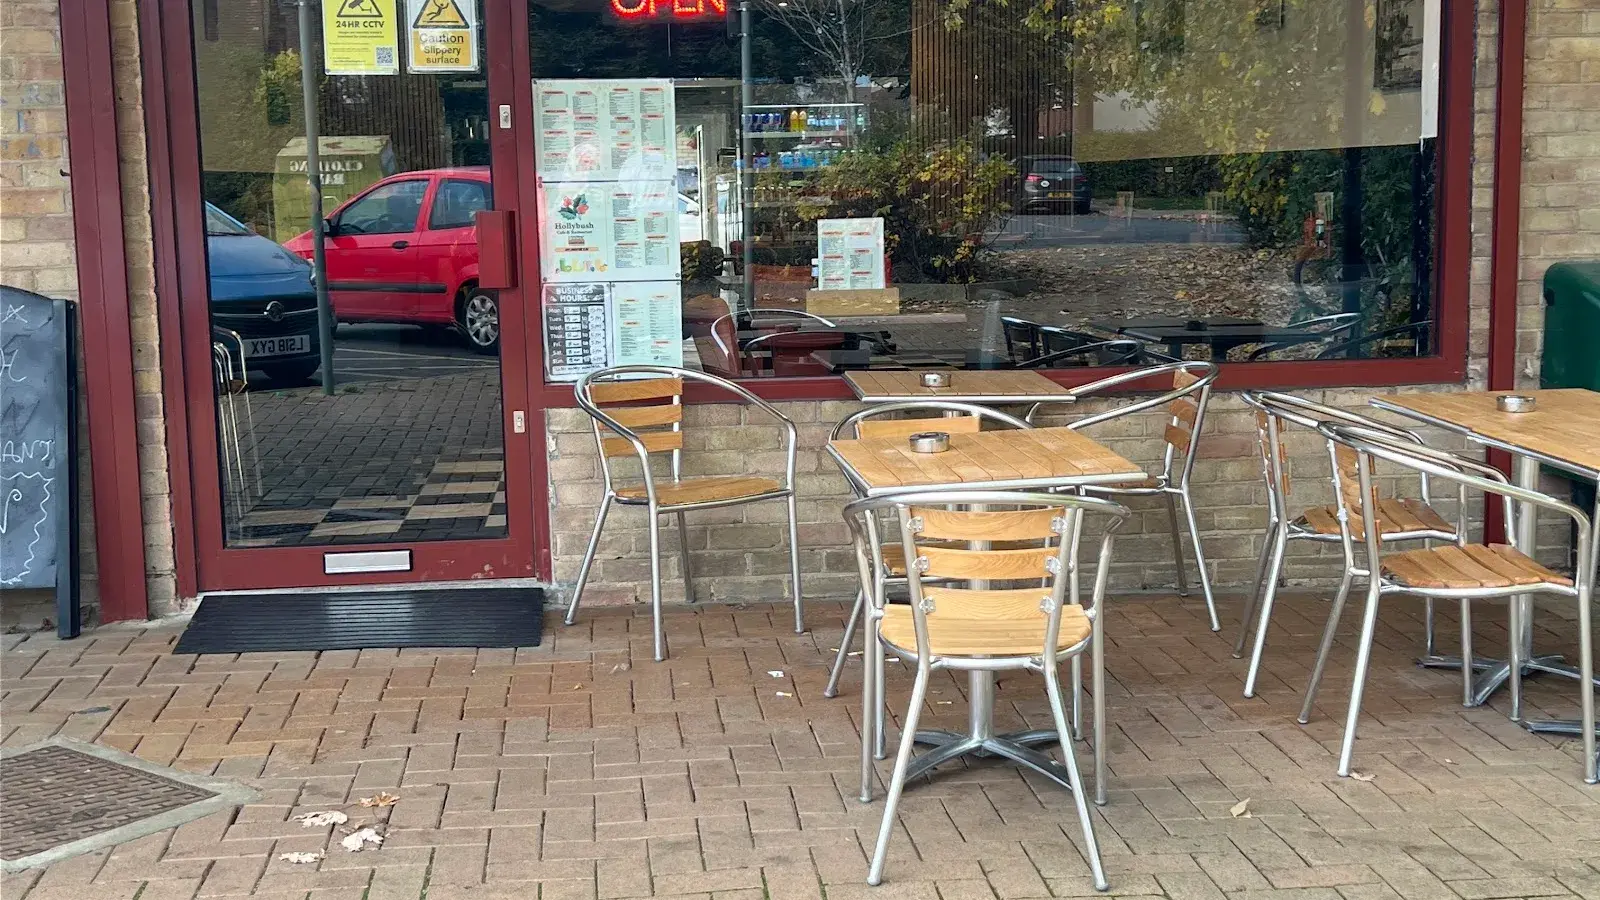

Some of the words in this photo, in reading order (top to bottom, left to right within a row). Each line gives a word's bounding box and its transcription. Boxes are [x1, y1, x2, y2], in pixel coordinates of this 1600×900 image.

[363, 20, 385, 29] CCTV
[419, 33, 464, 44] Caution
[423, 46, 462, 56] Slippery
[426, 55, 460, 64] surface
[554, 222, 594, 231] Hollybush
[556, 287, 594, 295] BUSINESS
[0, 439, 55, 464] ANT
